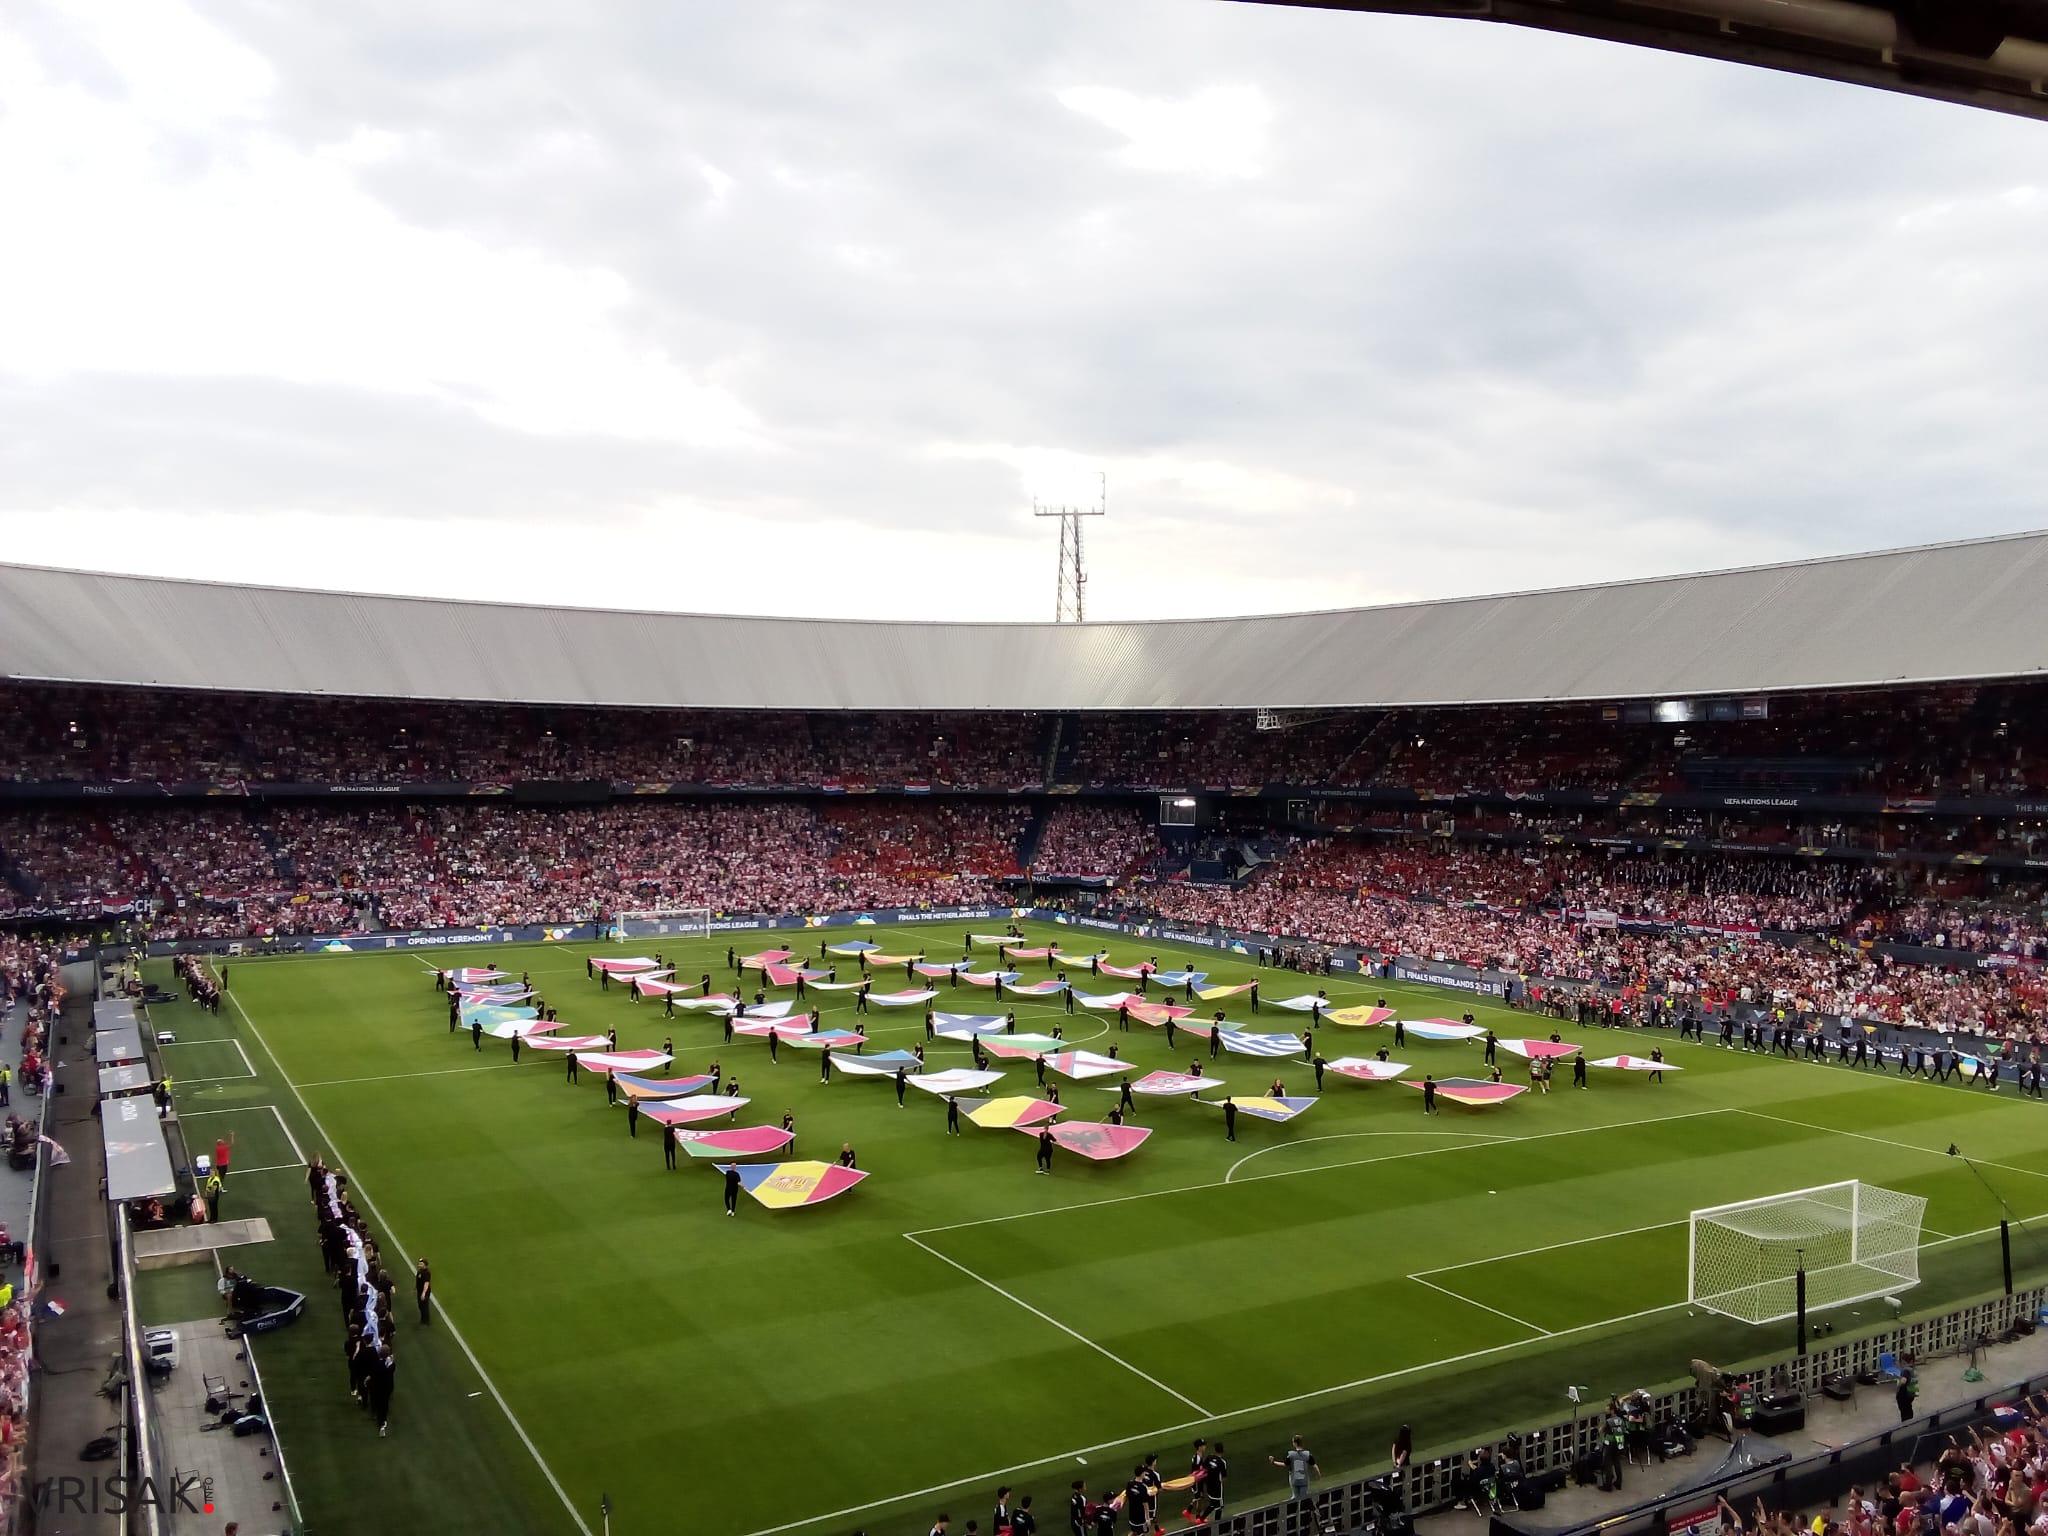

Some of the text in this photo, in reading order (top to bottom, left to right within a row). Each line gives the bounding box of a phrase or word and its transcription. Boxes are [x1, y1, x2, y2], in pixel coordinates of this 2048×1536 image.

[83, 786, 113, 794] FINALS
[1741, 798, 1770, 806] NATIONS
[2015, 804, 2033, 812] THE
[408, 934, 493, 945] OPENING CEREMONY
[1163, 931, 1214, 946] UEFA NATIONS LEAGUE
[1406, 971, 1491, 992] FINALS NETHERLANDS 223
